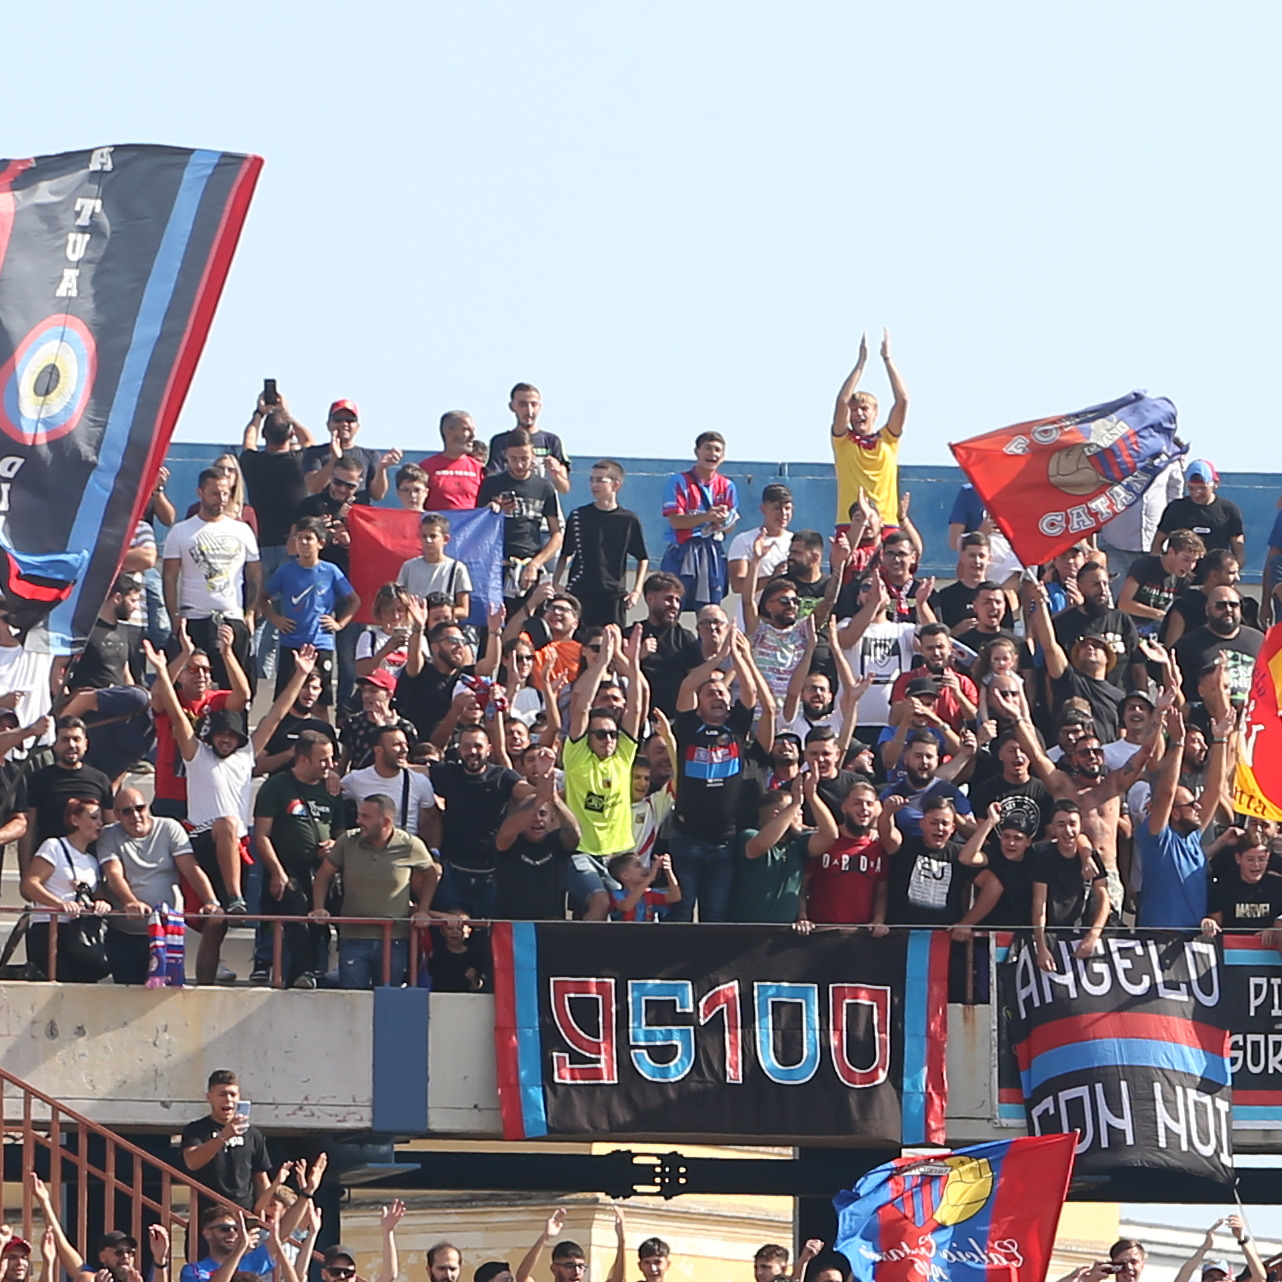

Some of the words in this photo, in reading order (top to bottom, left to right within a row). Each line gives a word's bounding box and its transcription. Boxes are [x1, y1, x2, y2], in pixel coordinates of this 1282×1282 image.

[1016, 934, 1221, 1020] ANGELO
[550, 976, 893, 1088] 95100
[1152, 1080, 1233, 1169] NOI
